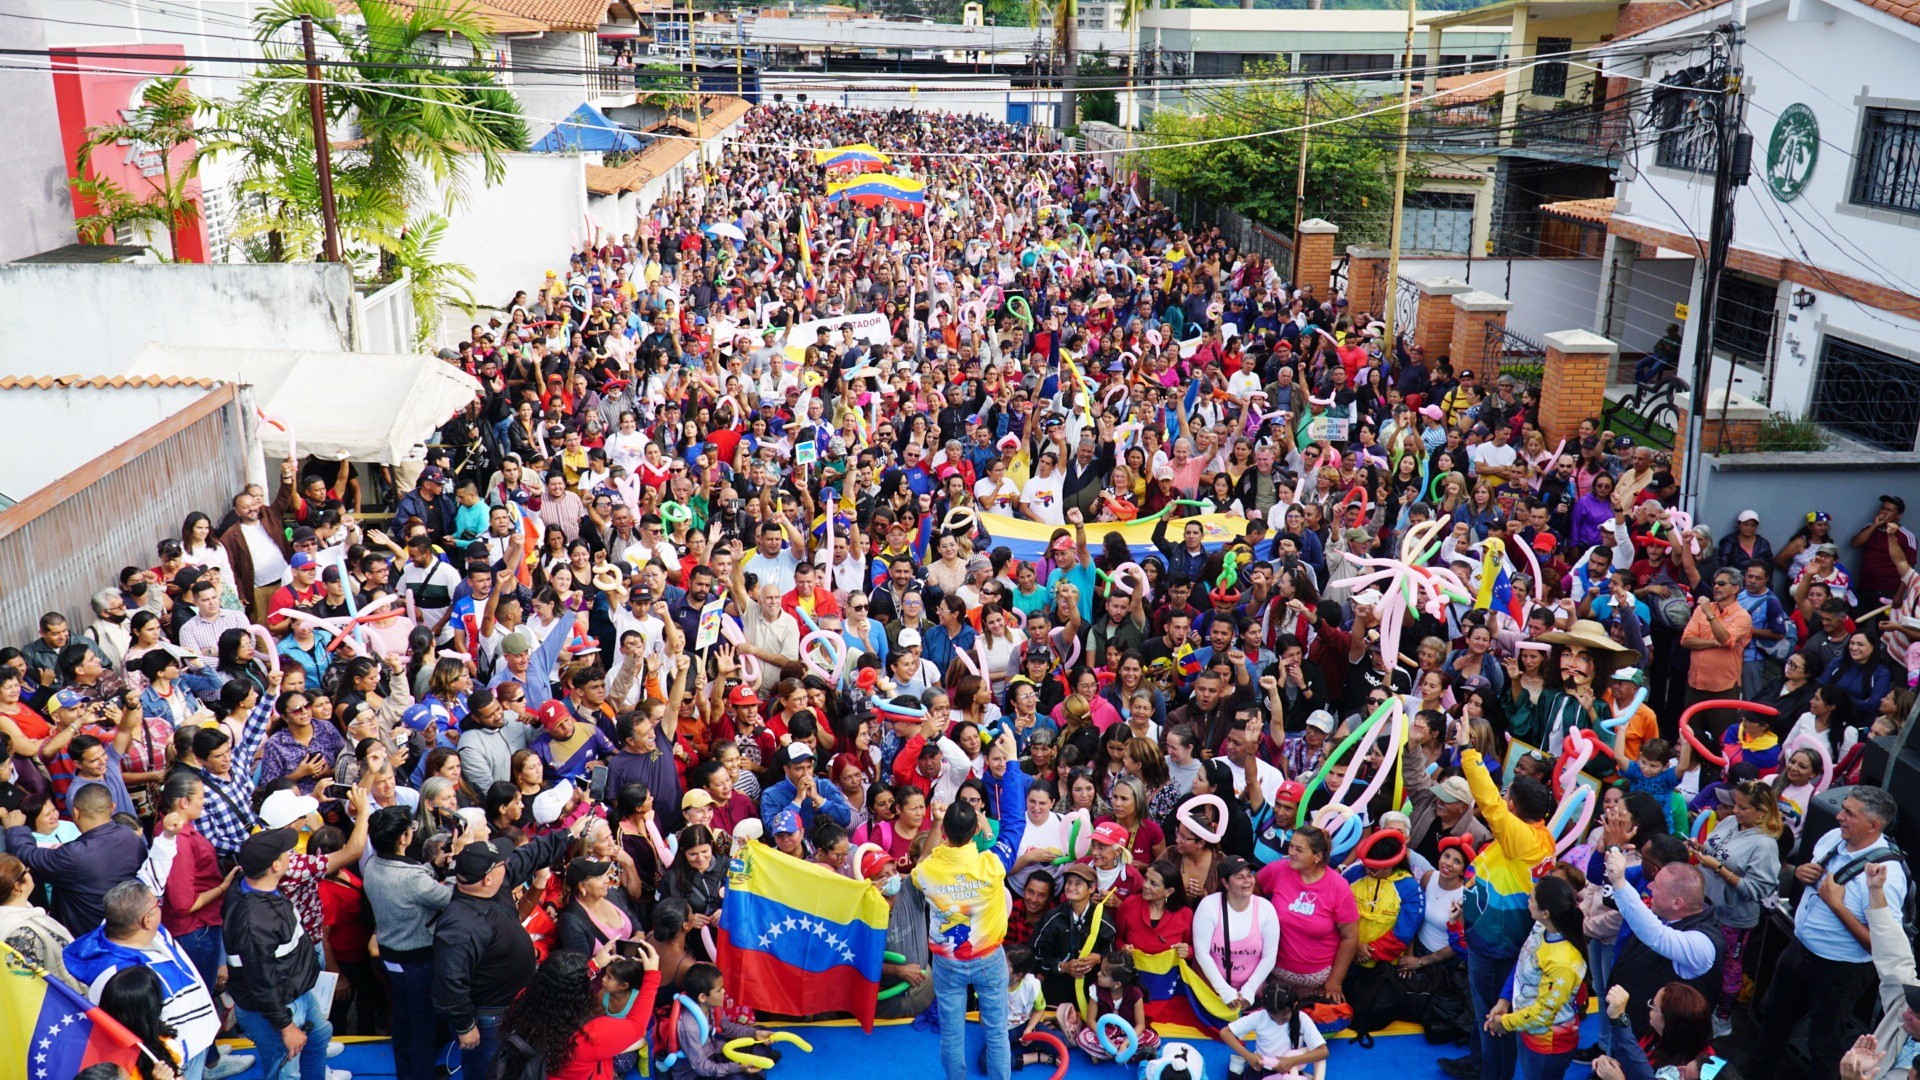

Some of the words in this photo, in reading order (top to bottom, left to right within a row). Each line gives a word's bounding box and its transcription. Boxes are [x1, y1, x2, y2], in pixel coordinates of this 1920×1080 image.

[829, 317, 881, 332] IBTADOR
[955, 873, 966, 883] SI
[933, 880, 992, 895] VENEZUELA
[950, 889, 979, 901] TODA
